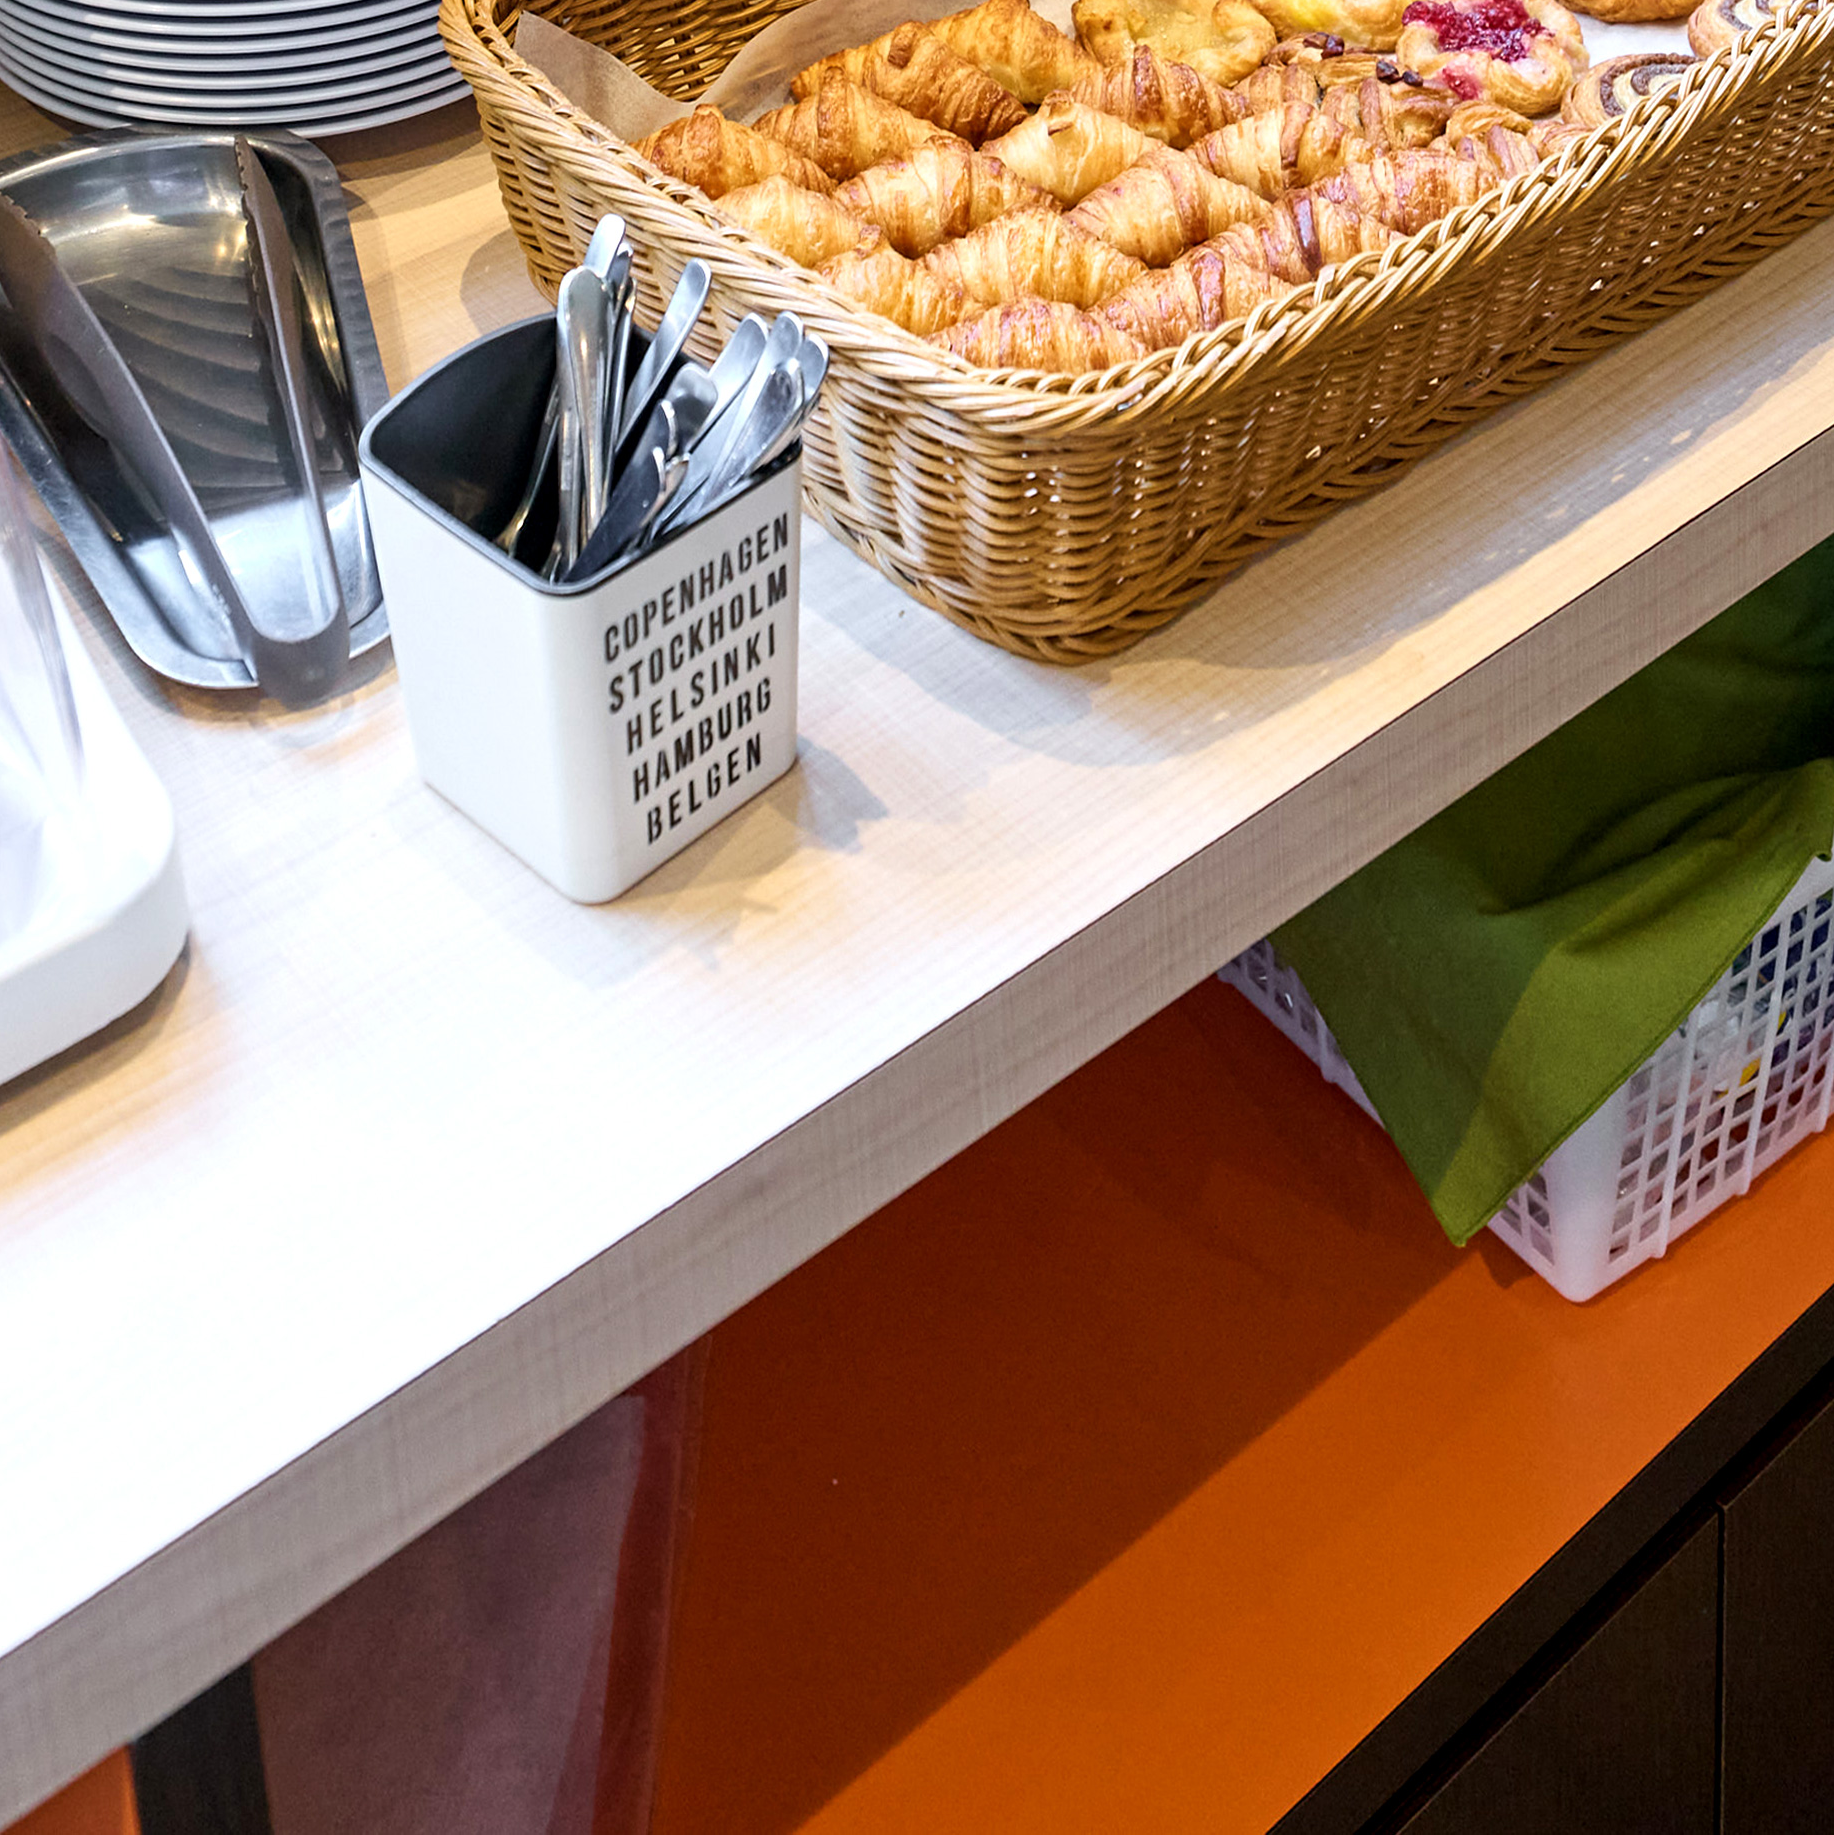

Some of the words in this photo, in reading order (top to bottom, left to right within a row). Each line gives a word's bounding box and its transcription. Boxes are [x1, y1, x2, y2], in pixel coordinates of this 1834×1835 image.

[604, 512, 788, 664] COPENHAGEN
[609, 563, 788, 715] STOCKHOLM
[626, 622, 776, 756] HELSINKI
[633, 676, 771, 804] HAMBURG
[647, 732, 762, 846] BELGEN
